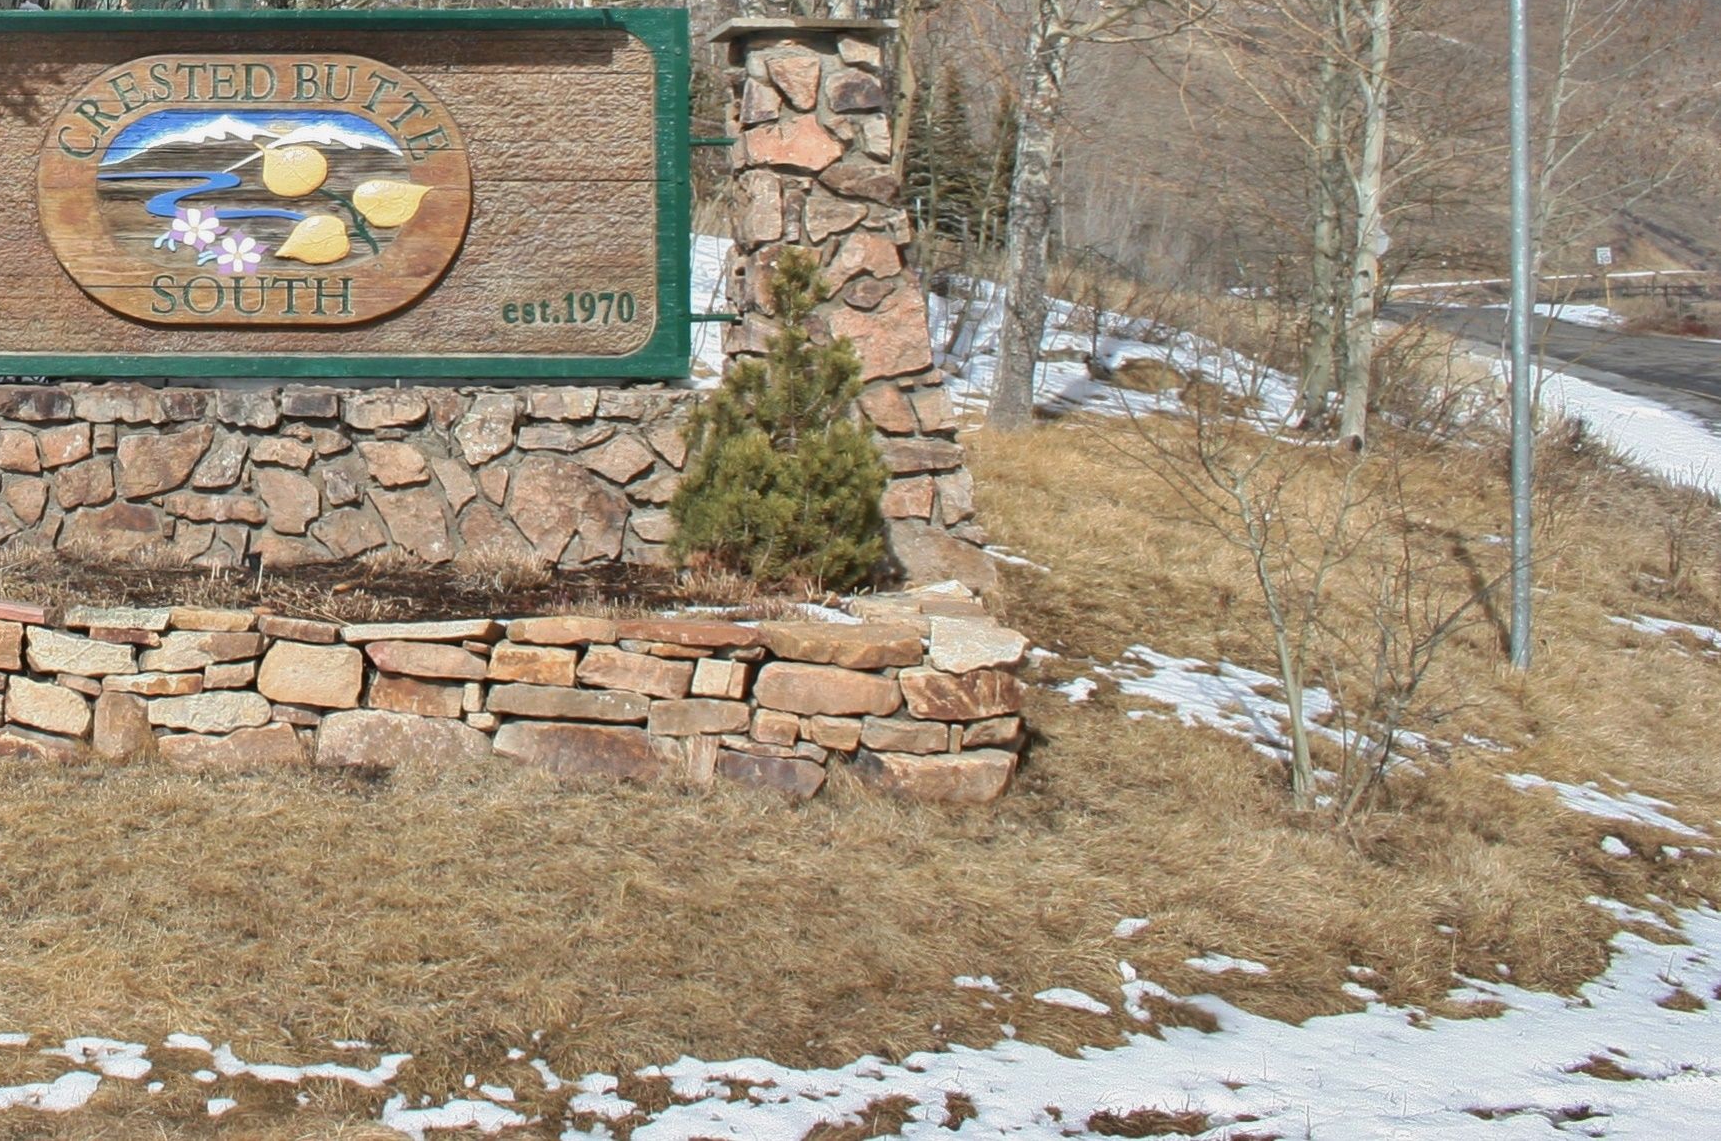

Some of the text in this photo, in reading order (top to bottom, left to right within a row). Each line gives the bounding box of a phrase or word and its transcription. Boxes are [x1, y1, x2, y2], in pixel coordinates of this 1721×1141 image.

[58, 62, 453, 162] CRESTED BUTTE
[151, 275, 354, 316] SOUTH
